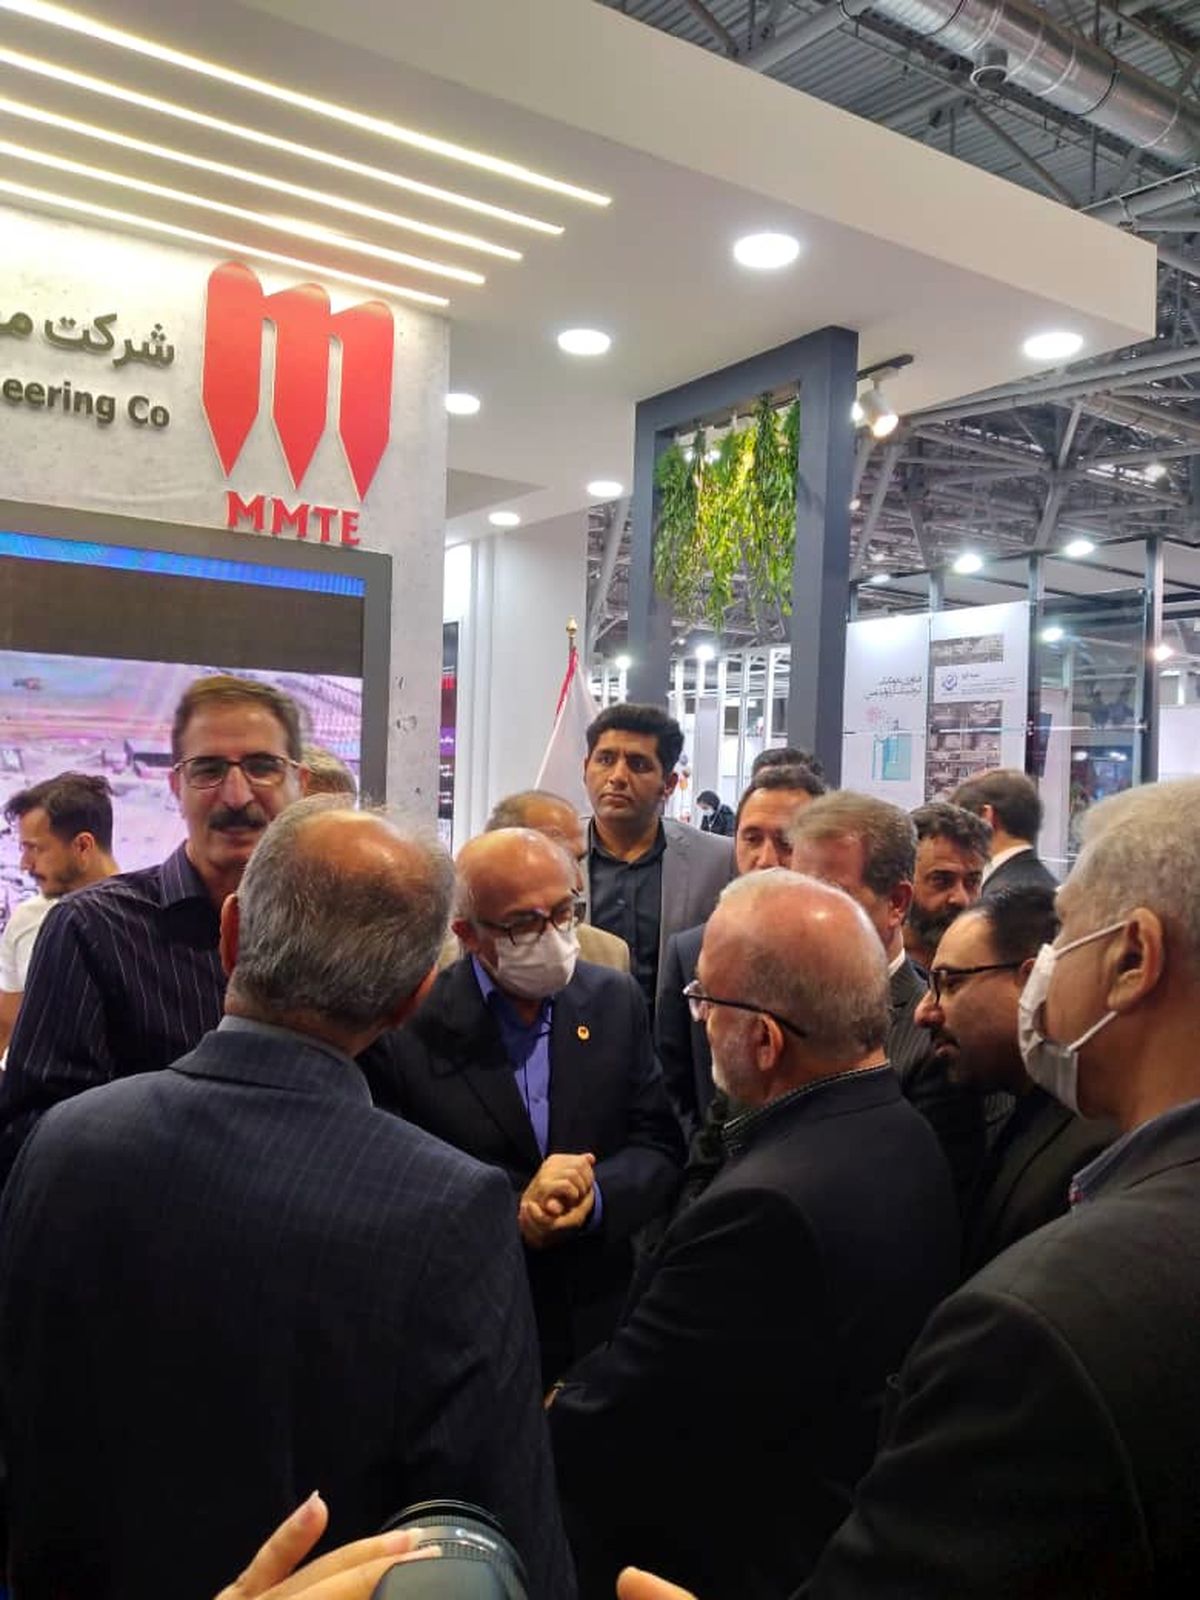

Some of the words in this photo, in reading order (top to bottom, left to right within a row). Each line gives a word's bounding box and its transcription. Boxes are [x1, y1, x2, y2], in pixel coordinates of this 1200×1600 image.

[44, 313, 175, 368] شرکت
[127, 395, 170, 427] Co
[227, 491, 361, 545] MMTE
